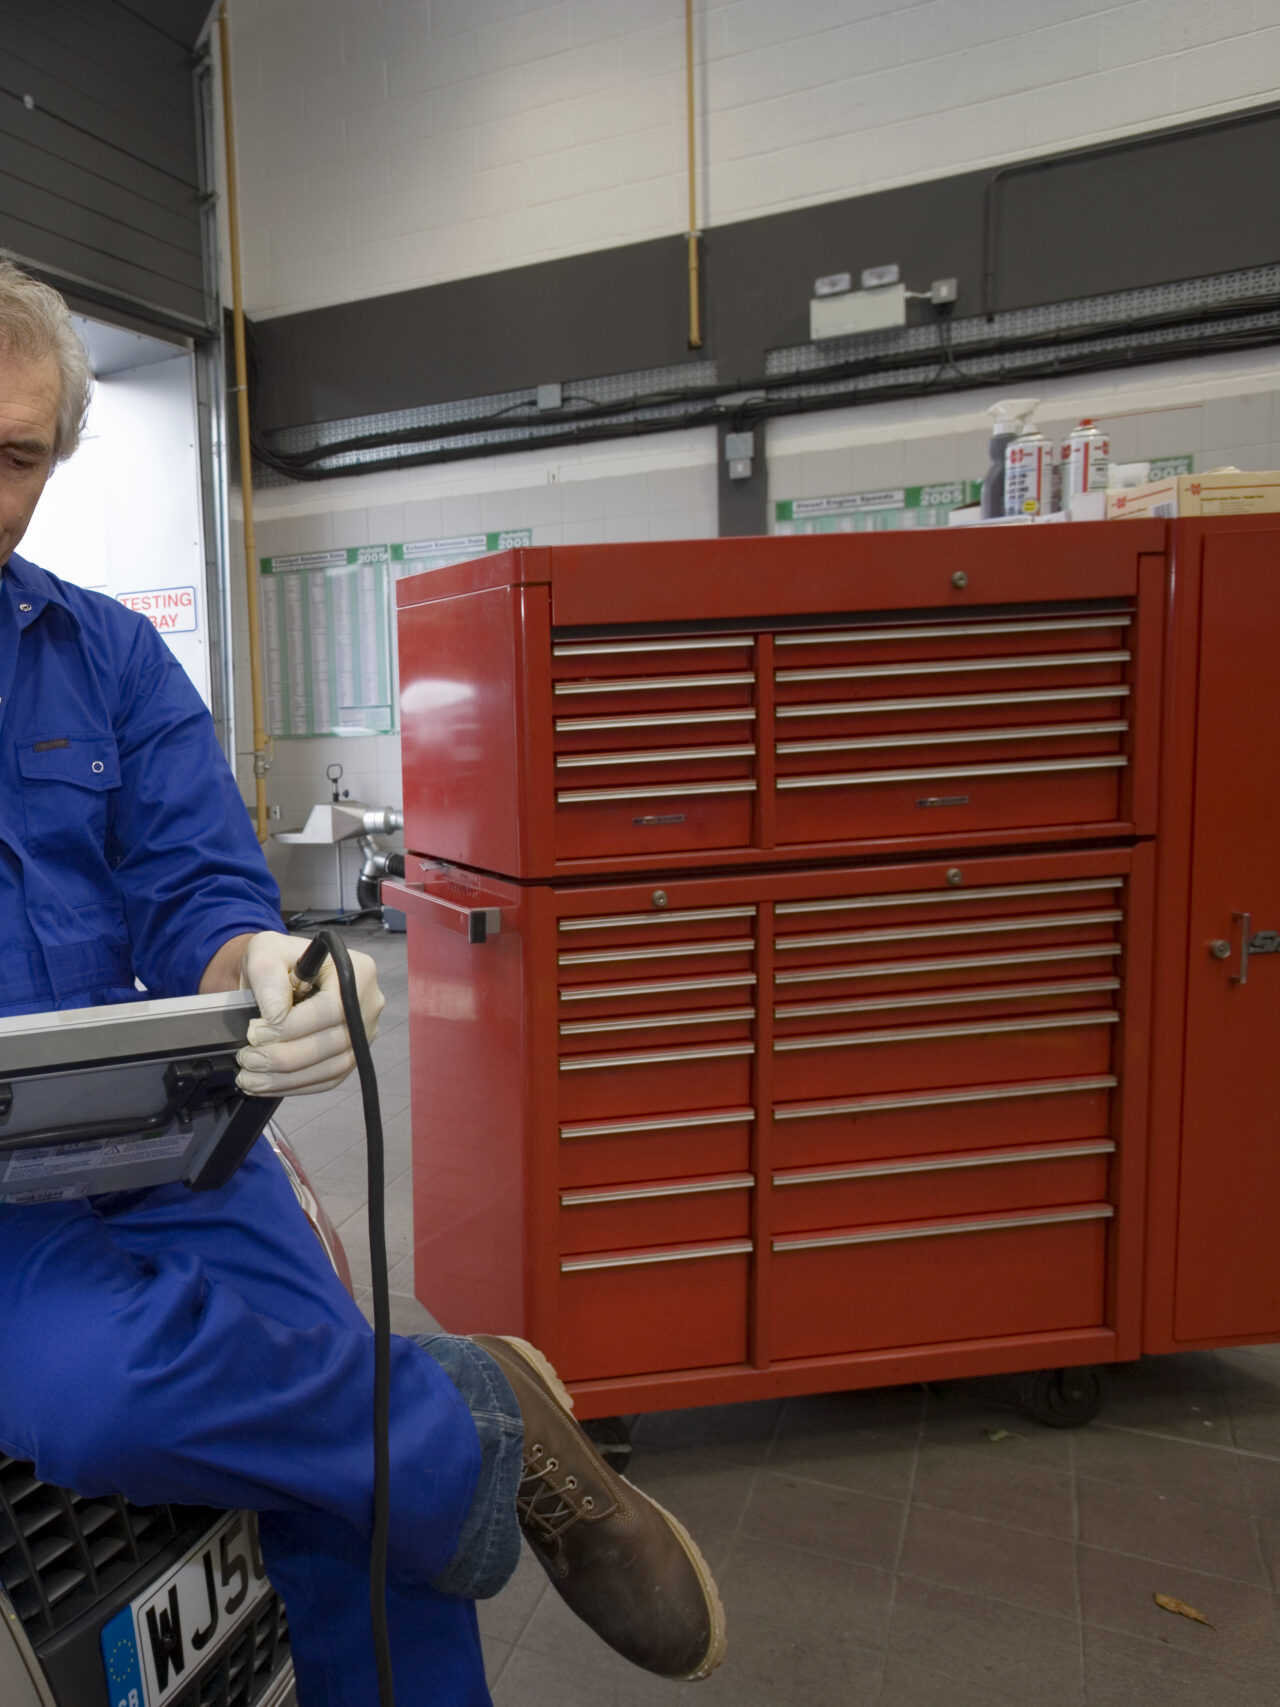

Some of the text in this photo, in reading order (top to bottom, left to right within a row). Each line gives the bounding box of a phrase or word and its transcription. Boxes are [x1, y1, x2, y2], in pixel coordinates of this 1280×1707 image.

[826, 496, 858, 507] Engine
[921, 492, 963, 505] 2005
[498, 537, 530, 549] 2005
[358, 553, 387, 564] 2005
[120, 592, 192, 611] TESTING
[149, 614, 178, 629] BAY
